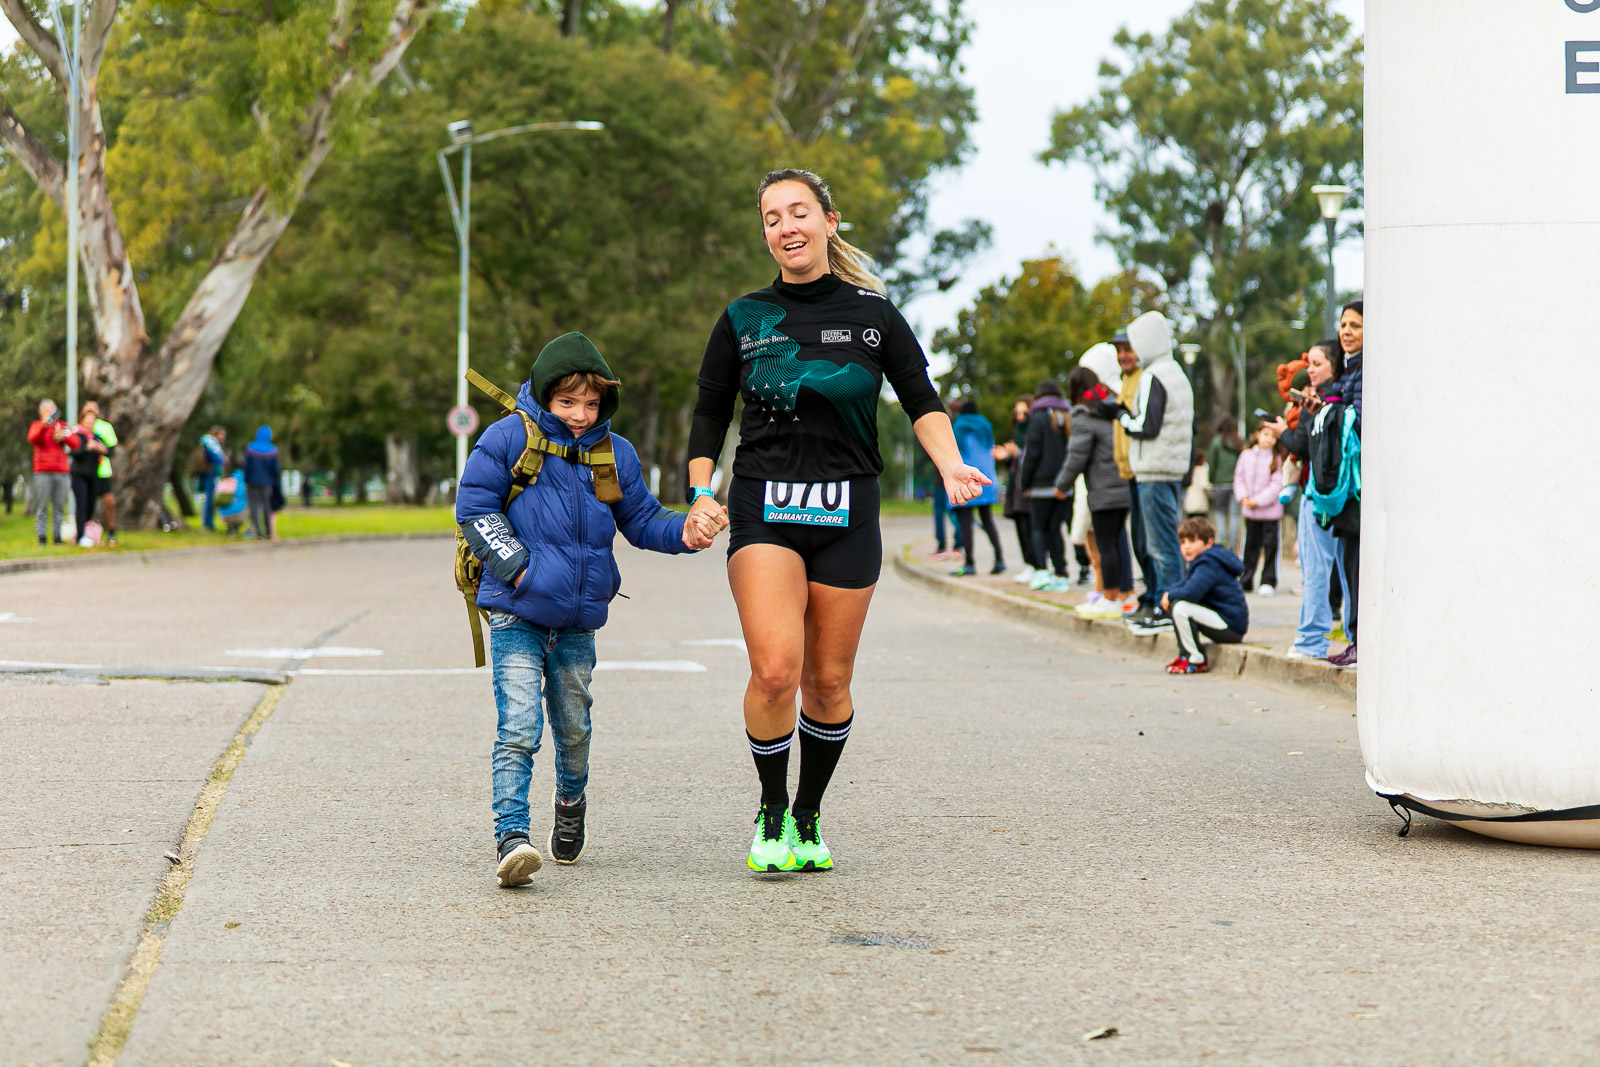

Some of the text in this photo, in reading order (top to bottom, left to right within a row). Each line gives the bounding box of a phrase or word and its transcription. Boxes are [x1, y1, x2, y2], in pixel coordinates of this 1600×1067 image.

[741, 335, 789, 351] Mercedes-Benz
[768, 512, 844, 524] DIAMANTE CORRE
[473, 518, 515, 560] BATIC
